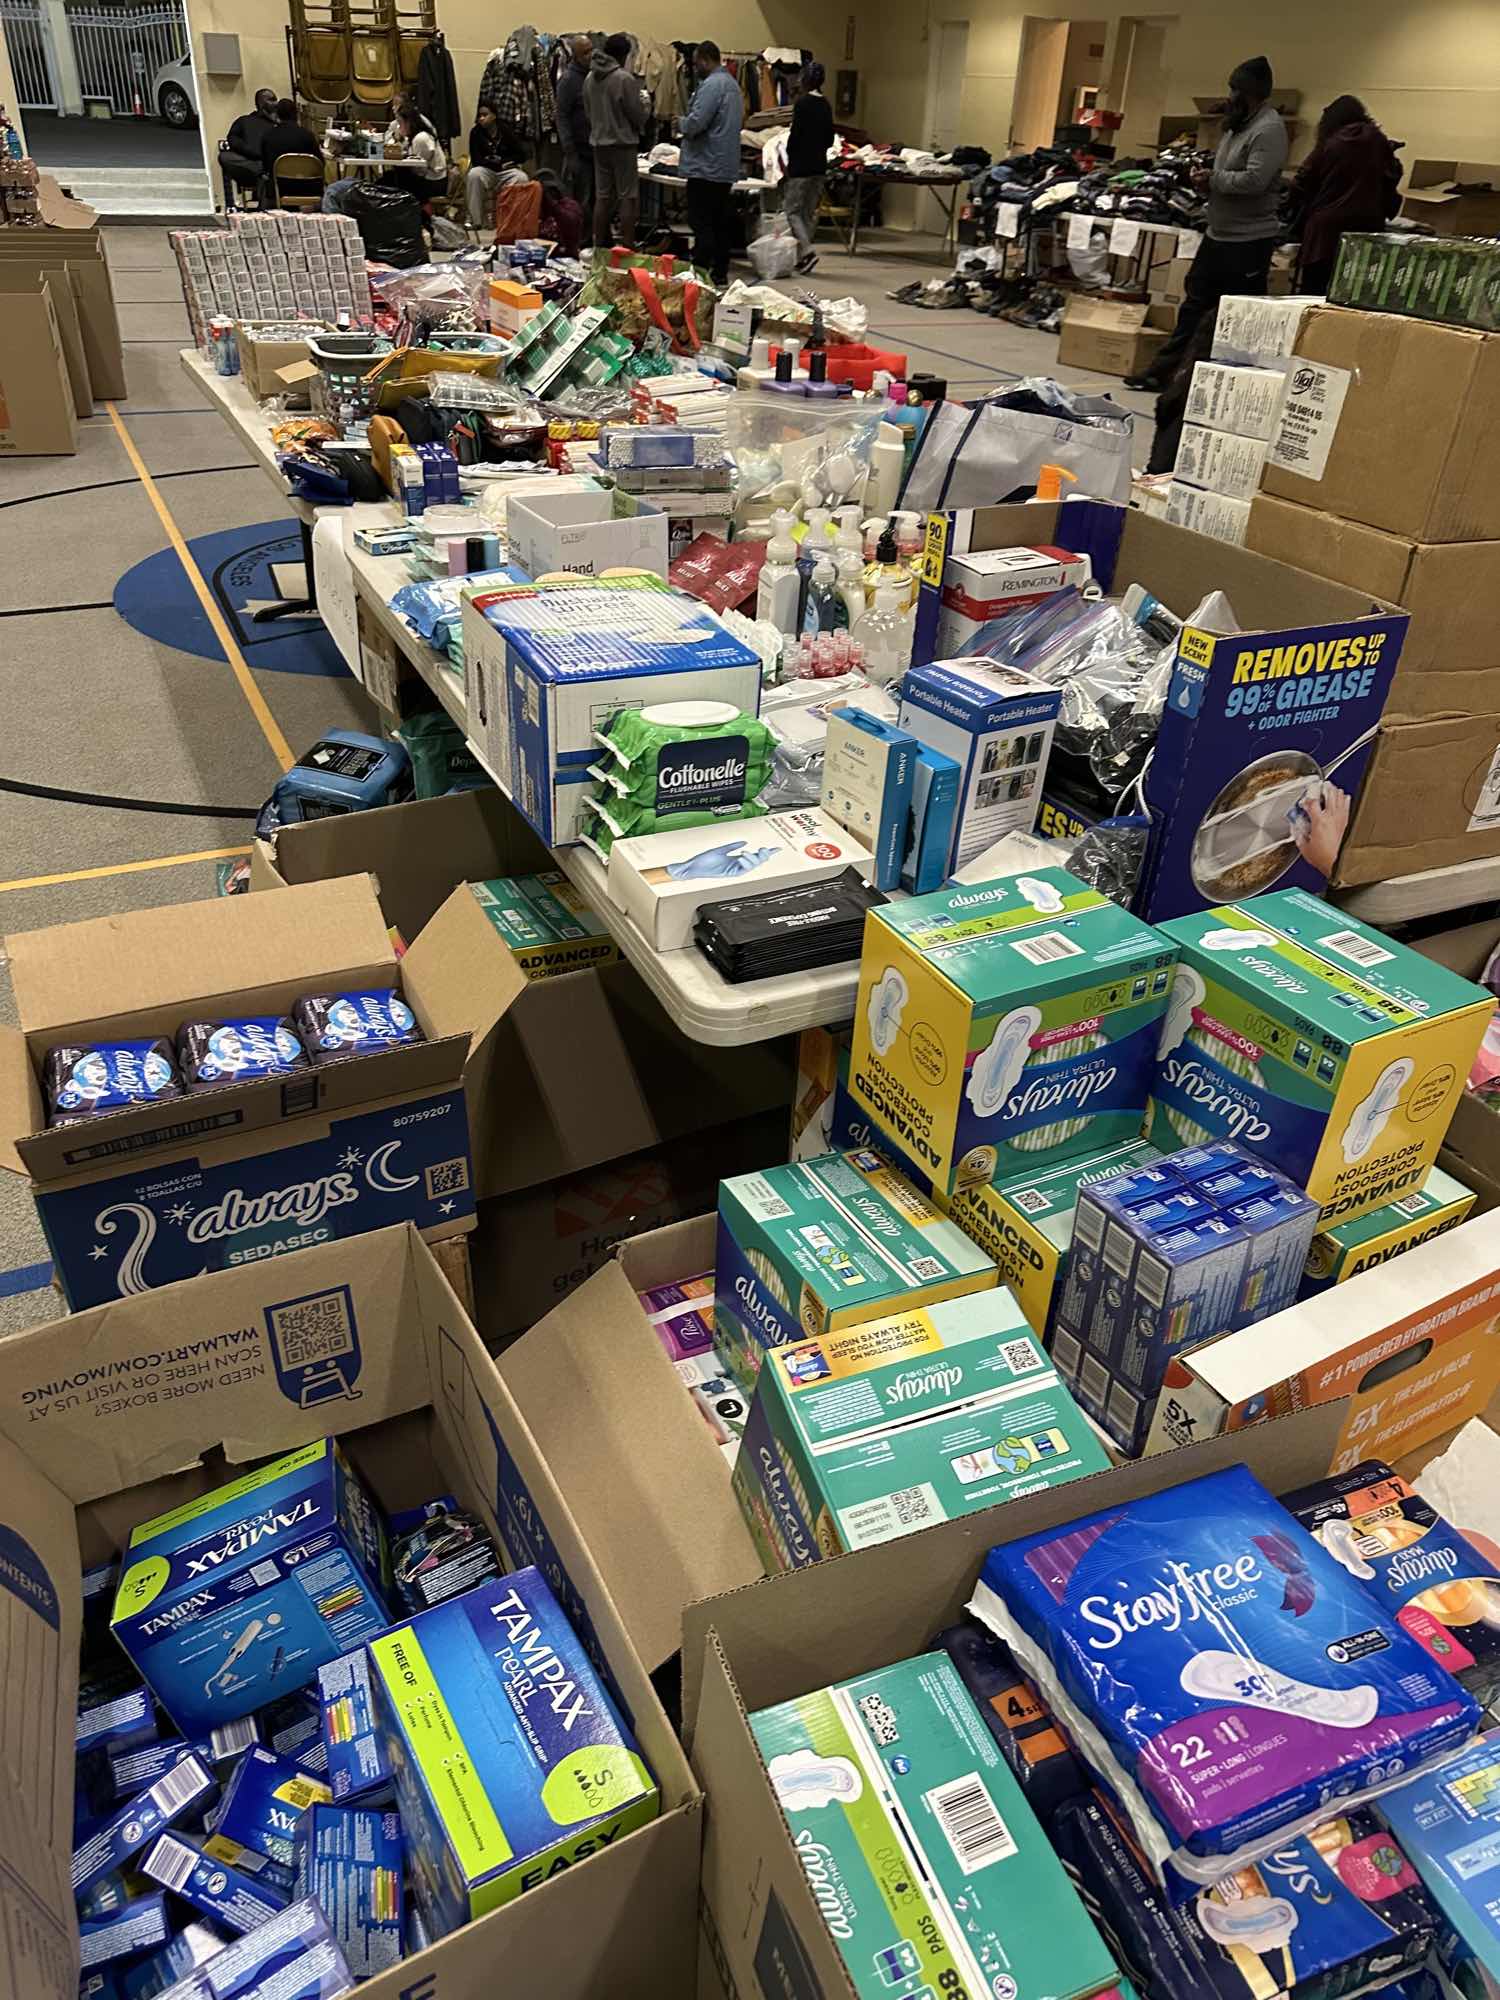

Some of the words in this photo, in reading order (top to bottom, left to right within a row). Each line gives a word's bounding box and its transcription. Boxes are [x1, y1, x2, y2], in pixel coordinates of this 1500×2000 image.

[561, 560, 594, 575] Hand
[1001, 575, 1059, 593] REMINGTON
[549, 602, 637, 616] wipes
[1182, 645, 1208, 664] SCENT
[1187, 633, 1209, 650] NEW
[1368, 633, 1387, 650] UP
[1177, 661, 1206, 682] FRESH
[1232, 636, 1365, 685] REMOVES
[1364, 650, 1380, 666] TO
[908, 683, 943, 710] Portable
[942, 698, 972, 723] Heater
[1258, 699, 1272, 714] OF
[1275, 669, 1377, 711] GREASE
[986, 707, 1025, 726] Portable
[1023, 702, 1055, 719] Heater
[1257, 713, 1291, 732] ODOR
[1291, 705, 1340, 725] FIGHTER
[658, 758, 746, 789] Cottonelle
[896, 751, 908, 786] ANKER
[669, 782, 712, 794] FLUSHABLE
[711, 778, 735, 789] WIPES
[812, 843, 836, 859] 100
[948, 885, 1009, 909] always
[519, 943, 612, 970] ADVANCED
[1236, 953, 1309, 996] always
[360, 996, 395, 1043] always
[1376, 998, 1405, 1015] 88
[241, 1023, 277, 1068] always
[115, 1049, 141, 1098] always
[1044, 1068, 1071, 1085] THIN
[1072, 1058, 1107, 1073] ULTRA
[1202, 1067, 1226, 1087] THIN
[867, 1052, 934, 1126] PROTECTION
[1003, 1066, 1117, 1120] always
[1162, 1058, 1272, 1142] always
[1225, 1084, 1261, 1113] ULTRA
[392, 1103, 452, 1129] 80759207
[867, 1070, 932, 1140] COREBOOST
[855, 1072, 942, 1169] ADVANCED
[1334, 1139, 1425, 1182] PROTECTION
[147, 1177, 180, 1193] BOLSAS
[182, 1172, 202, 1185] CON
[148, 1183, 184, 1200] TOALLAS
[1327, 1155, 1417, 1201] COREBOOST
[1319, 1164, 1425, 1221] ADVANCE
[186, 1172, 358, 1244] always
[853, 1196, 903, 1238] always
[228, 1226, 330, 1265] SEDASEC
[951, 1195, 1029, 1273] COREBOOST
[1349, 1212, 1460, 1276] ADVANCED
[861, 1325, 902, 1344] ALWAYS
[896, 1328, 927, 1342] MATTER
[903, 1319, 924, 1331] TRY
[828, 1336, 860, 1352] NIGHT
[857, 1341, 875, 1351] YOU
[865, 1340, 914, 1359] PROTECTION
[875, 1335, 896, 1346] HOW
[913, 1334, 930, 1344] FOR
[1319, 1365, 1344, 1390] #1
[1343, 1334, 1403, 1377] POWDERED
[1401, 1305, 1458, 1346] HYDRATION
[22, 1326, 260, 1405] WALMART.COM/MOVING
[214, 1345, 263, 1369] SCAN
[831, 1346, 856, 1360] SLEEP
[849, 1352, 864, 1362] NO
[131, 1373, 160, 1389] OR
[165, 1360, 211, 1382] HERE
[218, 1363, 266, 1386] NEED
[924, 1361, 950, 1374] ULTRA
[86, 1382, 128, 1403] VISIT
[164, 1377, 214, 1399] MORE
[885, 1365, 963, 1405] always
[28, 1405, 50, 1423] AT
[54, 1394, 80, 1413] US
[95, 1387, 159, 1418] BOXES?
[1165, 1397, 1198, 1436] 5X
[1347, 1397, 1389, 1439] 5X
[186, 1498, 322, 1579] TAMPAX
[1386, 1546, 1459, 1588] always
[1397, 1545, 1425, 1562] MAXI
[133, 1586, 146, 1599] S
[1079, 1553, 1264, 1651] Stayfree
[138, 1588, 217, 1636] TAMPAX
[391, 1642, 409, 1671] FREE
[404, 1670, 418, 1687] OF
[490, 1588, 595, 1733] TAMPAX
[502, 1680, 525, 1716] ADVANCED
[519, 1713, 540, 1751] ANTI-SLIP
[1006, 1694, 1025, 1719] 4
[1170, 1735, 1213, 1768] 22
[593, 1769, 614, 1787] S
[1190, 1764, 1221, 1785] SUPER
[1222, 1752, 1247, 1770] LONG
[520, 1823, 622, 1894] EASY
[824, 1854, 841, 1882] THIN
[1098, 1823, 1114, 1848] PADS
[1113, 1848, 1148, 1895] SERVIETTES
[794, 1829, 854, 1940] always
[838, 1884, 858, 1920] ULTRA
[916, 1915, 945, 1955] PADS
